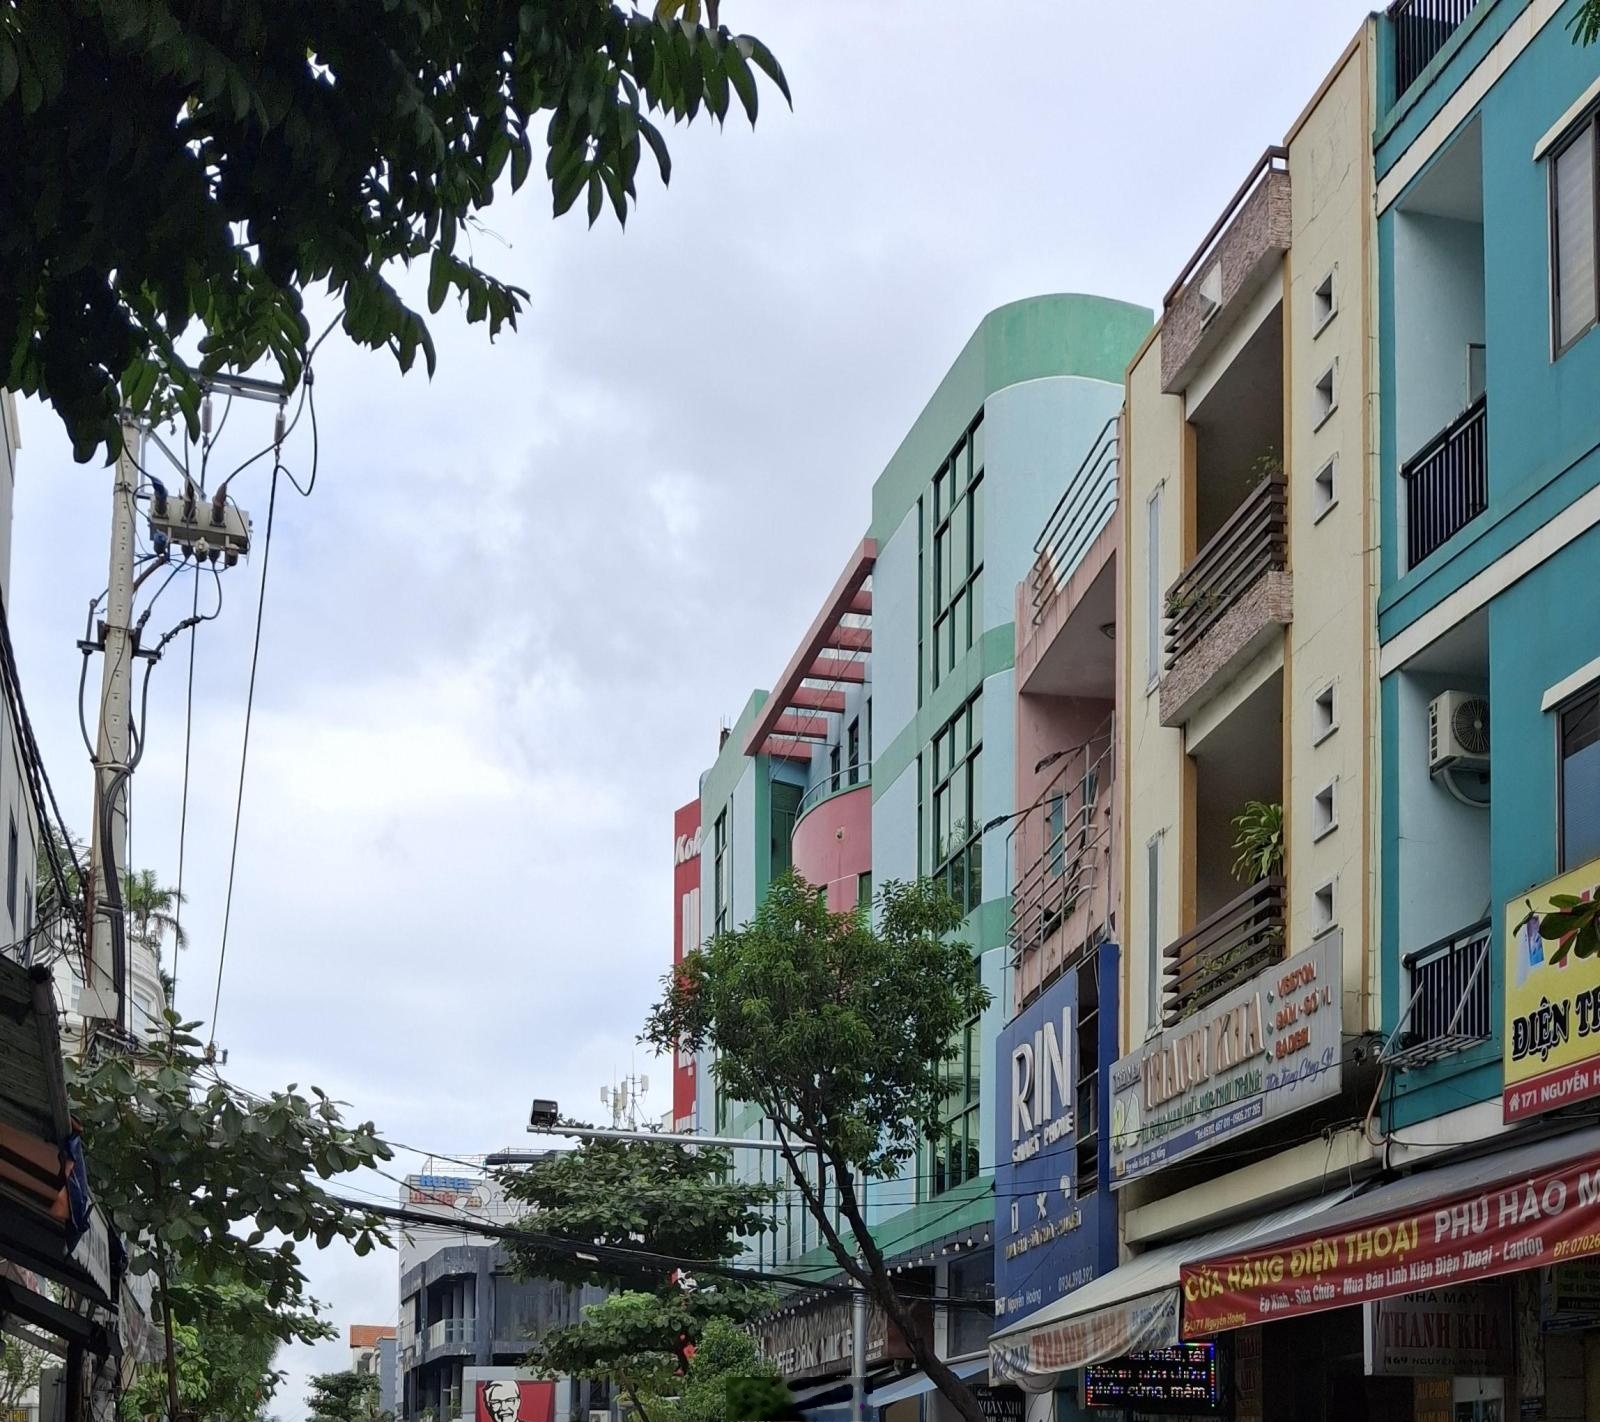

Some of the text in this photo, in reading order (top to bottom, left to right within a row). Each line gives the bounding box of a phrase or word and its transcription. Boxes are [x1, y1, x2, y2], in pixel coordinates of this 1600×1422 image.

[1141, 991, 1266, 1111] THANH KHA
[1512, 996, 1570, 1062] ĐIỆN
[1012, 1006, 1072, 1143] RIN
[1521, 1092, 1537, 1109] 171
[1043, 1111, 1074, 1147] PHONE
[1184, 1265, 1224, 1302] CỬA
[1228, 1256, 1284, 1292] HÀNG
[1290, 1238, 1339, 1281] ĐIỆN
[1344, 1218, 1418, 1265] THOẠI
[1344, 1277, 1363, 1295] Mua
[1366, 1271, 1384, 1290] Bán
[1410, 1262, 1433, 1283] Kiện
[1436, 1255, 1460, 1277] Điện
[1462, 1245, 1493, 1270] Thoại
[1503, 1236, 1544, 1261] Laptop
[1382, 1312, 1450, 1349] THANH
